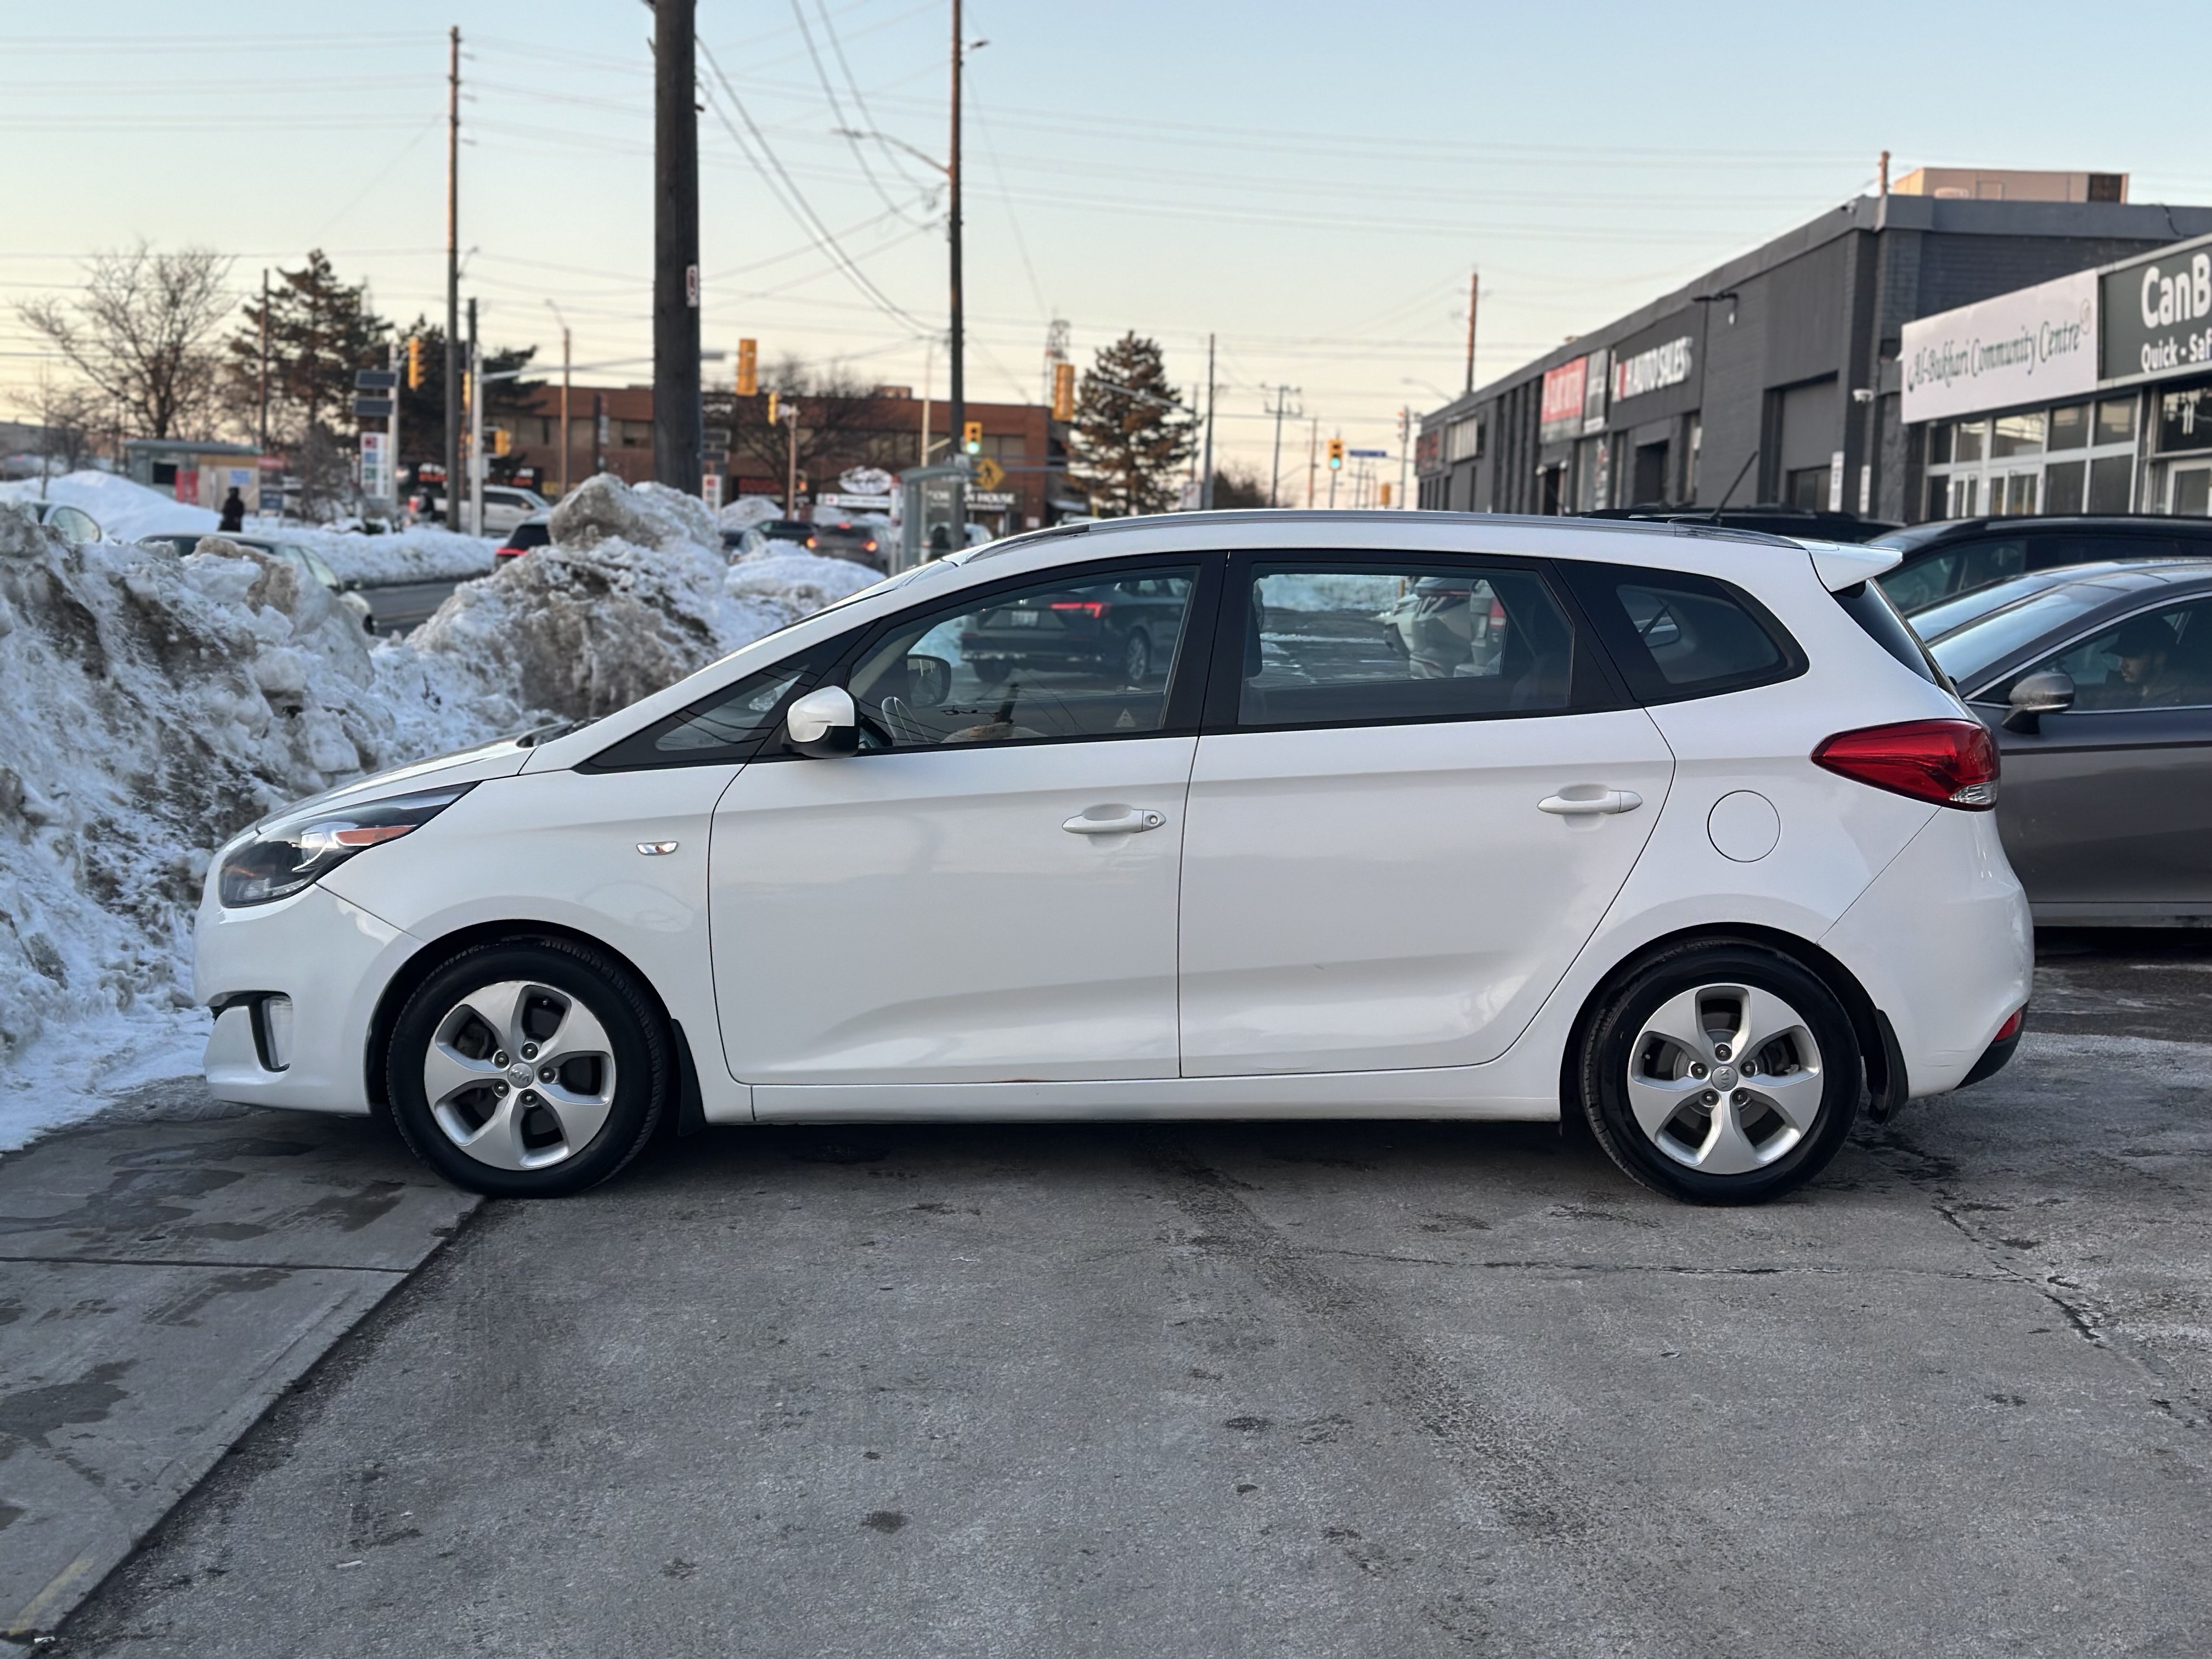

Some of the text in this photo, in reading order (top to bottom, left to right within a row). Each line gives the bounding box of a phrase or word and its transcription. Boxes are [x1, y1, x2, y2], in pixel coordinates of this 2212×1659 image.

[1971, 324, 2036, 376] Community
[2039, 320, 2081, 363] Centre
[2141, 336, 2179, 375] Quick
[510, 1069, 530, 1083] KIA
[1720, 1069, 1729, 1088] KIA
